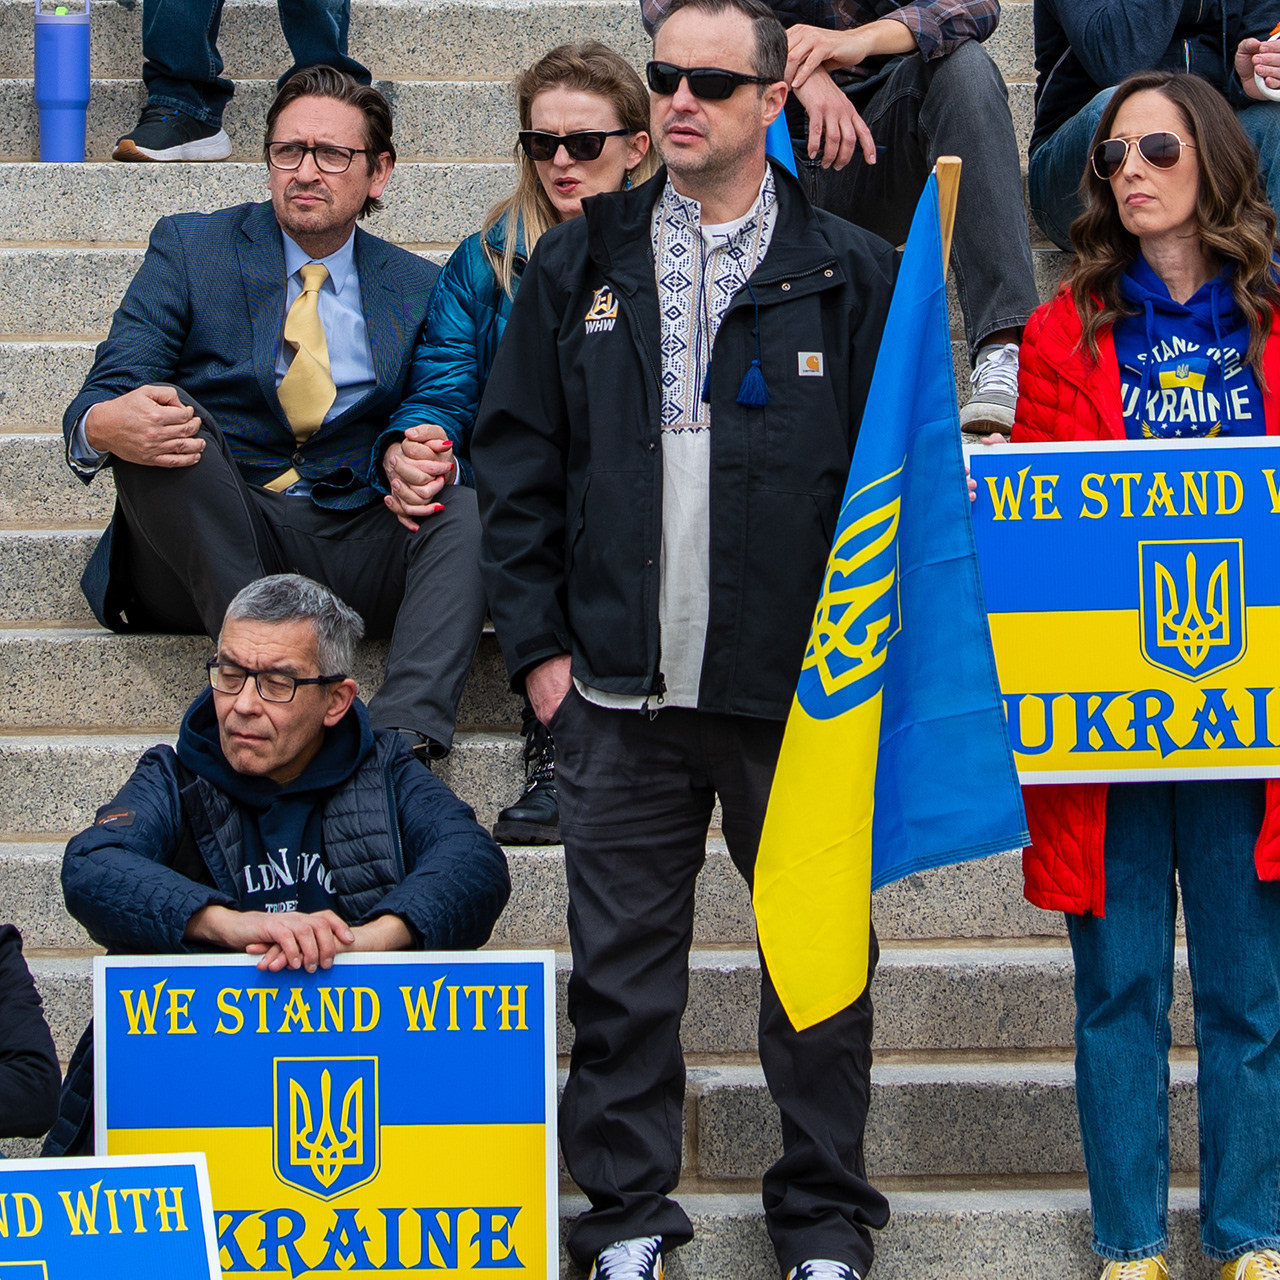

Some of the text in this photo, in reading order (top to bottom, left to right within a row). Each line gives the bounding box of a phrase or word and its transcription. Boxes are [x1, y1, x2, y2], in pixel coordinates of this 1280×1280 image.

[585, 318, 616, 335] WHW
[1137, 335, 1201, 367] STAND
[1119, 382, 1253, 423] UKRAINE
[983, 464, 1063, 522] WE
[1078, 470, 1246, 520] STAND
[119, 973, 530, 1037] WE STAND WITH
[57, 1176, 191, 1237] WITH
[214, 1206, 528, 1280] KRAINE
